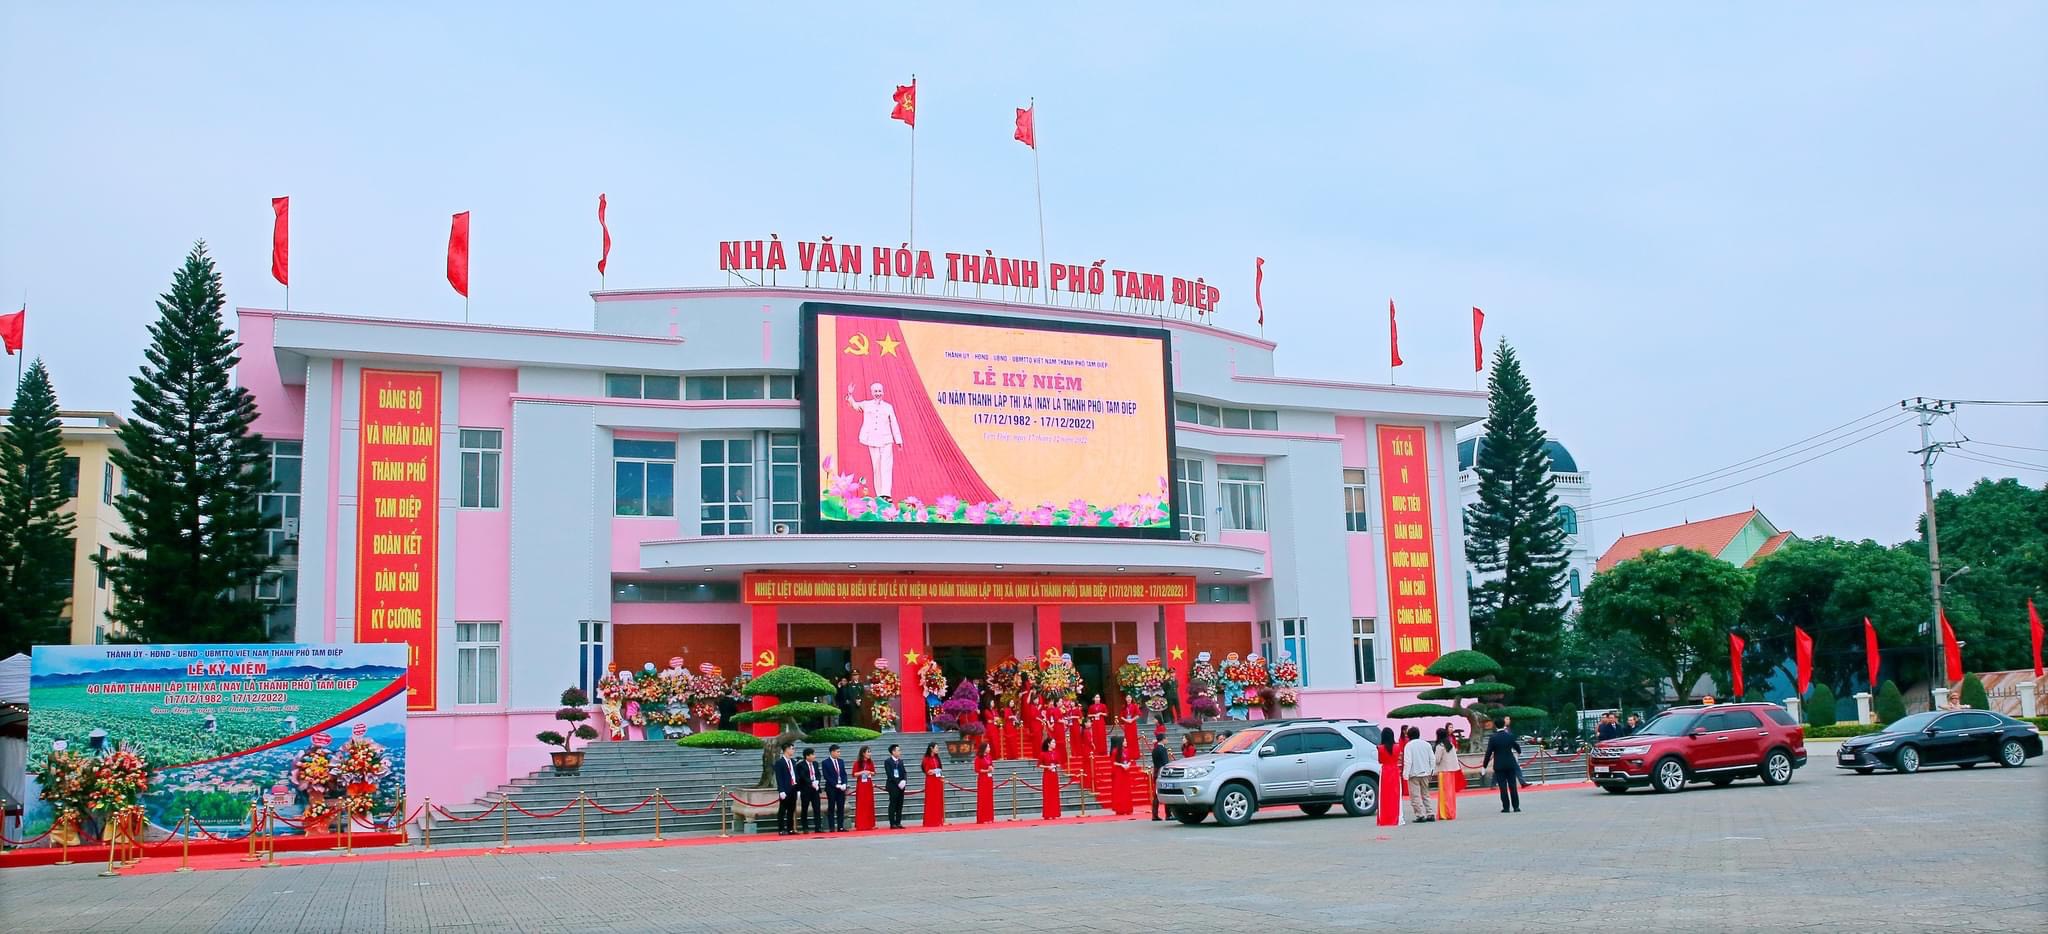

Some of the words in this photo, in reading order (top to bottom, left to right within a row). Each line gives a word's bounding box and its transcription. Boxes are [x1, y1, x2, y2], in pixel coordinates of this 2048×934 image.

[720, 234, 786, 270] NHÀ
[798, 236, 862, 274] VĂN
[873, 242, 934, 279] HÓA
[946, 250, 1038, 288] THÀNH
[1050, 260, 1106, 295] PHỐ
[1112, 270, 1164, 302] TAM
[1172, 277, 1220, 316] ĐIỆP
[973, 366, 996, 386] LỄ
[1002, 370, 1028, 388] KỶ
[1032, 373, 1082, 392] NIỆM
[379, 381, 406, 409] ĐẢNG
[409, 386, 422, 414] BỘ
[938, 392, 946, 404] 40
[994, 392, 1008, 410] LẬP
[1010, 395, 1020, 411] THỊ
[1106, 400, 1120, 414] TAM
[367, 420, 380, 444] VÀ
[382, 422, 410, 445] NHÂN
[412, 422, 432, 446] DÂN
[974, 413, 1030, 426] (17/12/1982
[1040, 416, 1094, 430] 17/12/2022)
[372, 457, 404, 481] THÀNH
[406, 456, 428, 482] PHỐ
[375, 498, 396, 518] TAM
[399, 494, 422, 522] ĐIỆP
[373, 530, 400, 555] ĐOÀN
[404, 528, 422, 555] KẾT
[375, 567, 396, 592] DÂN
[399, 563, 419, 592] CHỦ
[778, 580, 792, 600] LIỆT
[794, 580, 812, 596] CHÀO
[910, 581, 928, 600] NIỆM
[929, 584, 938, 596] 40
[938, 581, 954, 596] NĂM
[956, 581, 978, 596] THÀNH
[979, 581, 992, 600] LẬP
[993, 583, 1004, 600] THỊ
[1004, 581, 1014, 597] XÃ
[1015, 584, 1030, 598] (NAY
[1040, 581, 1062, 597] THÀNH
[1079, 584, 1092, 597] TAM
[1092, 582, 1107, 600] ĐIỆP
[1108, 584, 1144, 598] (17/12/1982
[1150, 584, 1184, 598] 17/12/2022)
[371, 600, 385, 630] KỶ
[387, 607, 422, 630] CƯƠNG
[178, 650, 198, 658] UBND
[204, 650, 234, 658] UBMTTQ
[188, 661, 204, 675] LỄ
[208, 660, 226, 675] KỶ
[231, 661, 266, 677] NIỆM
[88, 684, 100, 694] 40
[103, 682, 126, 694] NĂM
[164, 680, 182, 693] LẬP
[220, 682, 241, 690] (NAY
[316, 680, 334, 690] TAM
[164, 694, 222, 704] (17/12/1982
[232, 694, 288, 703] 17/12/2022)
